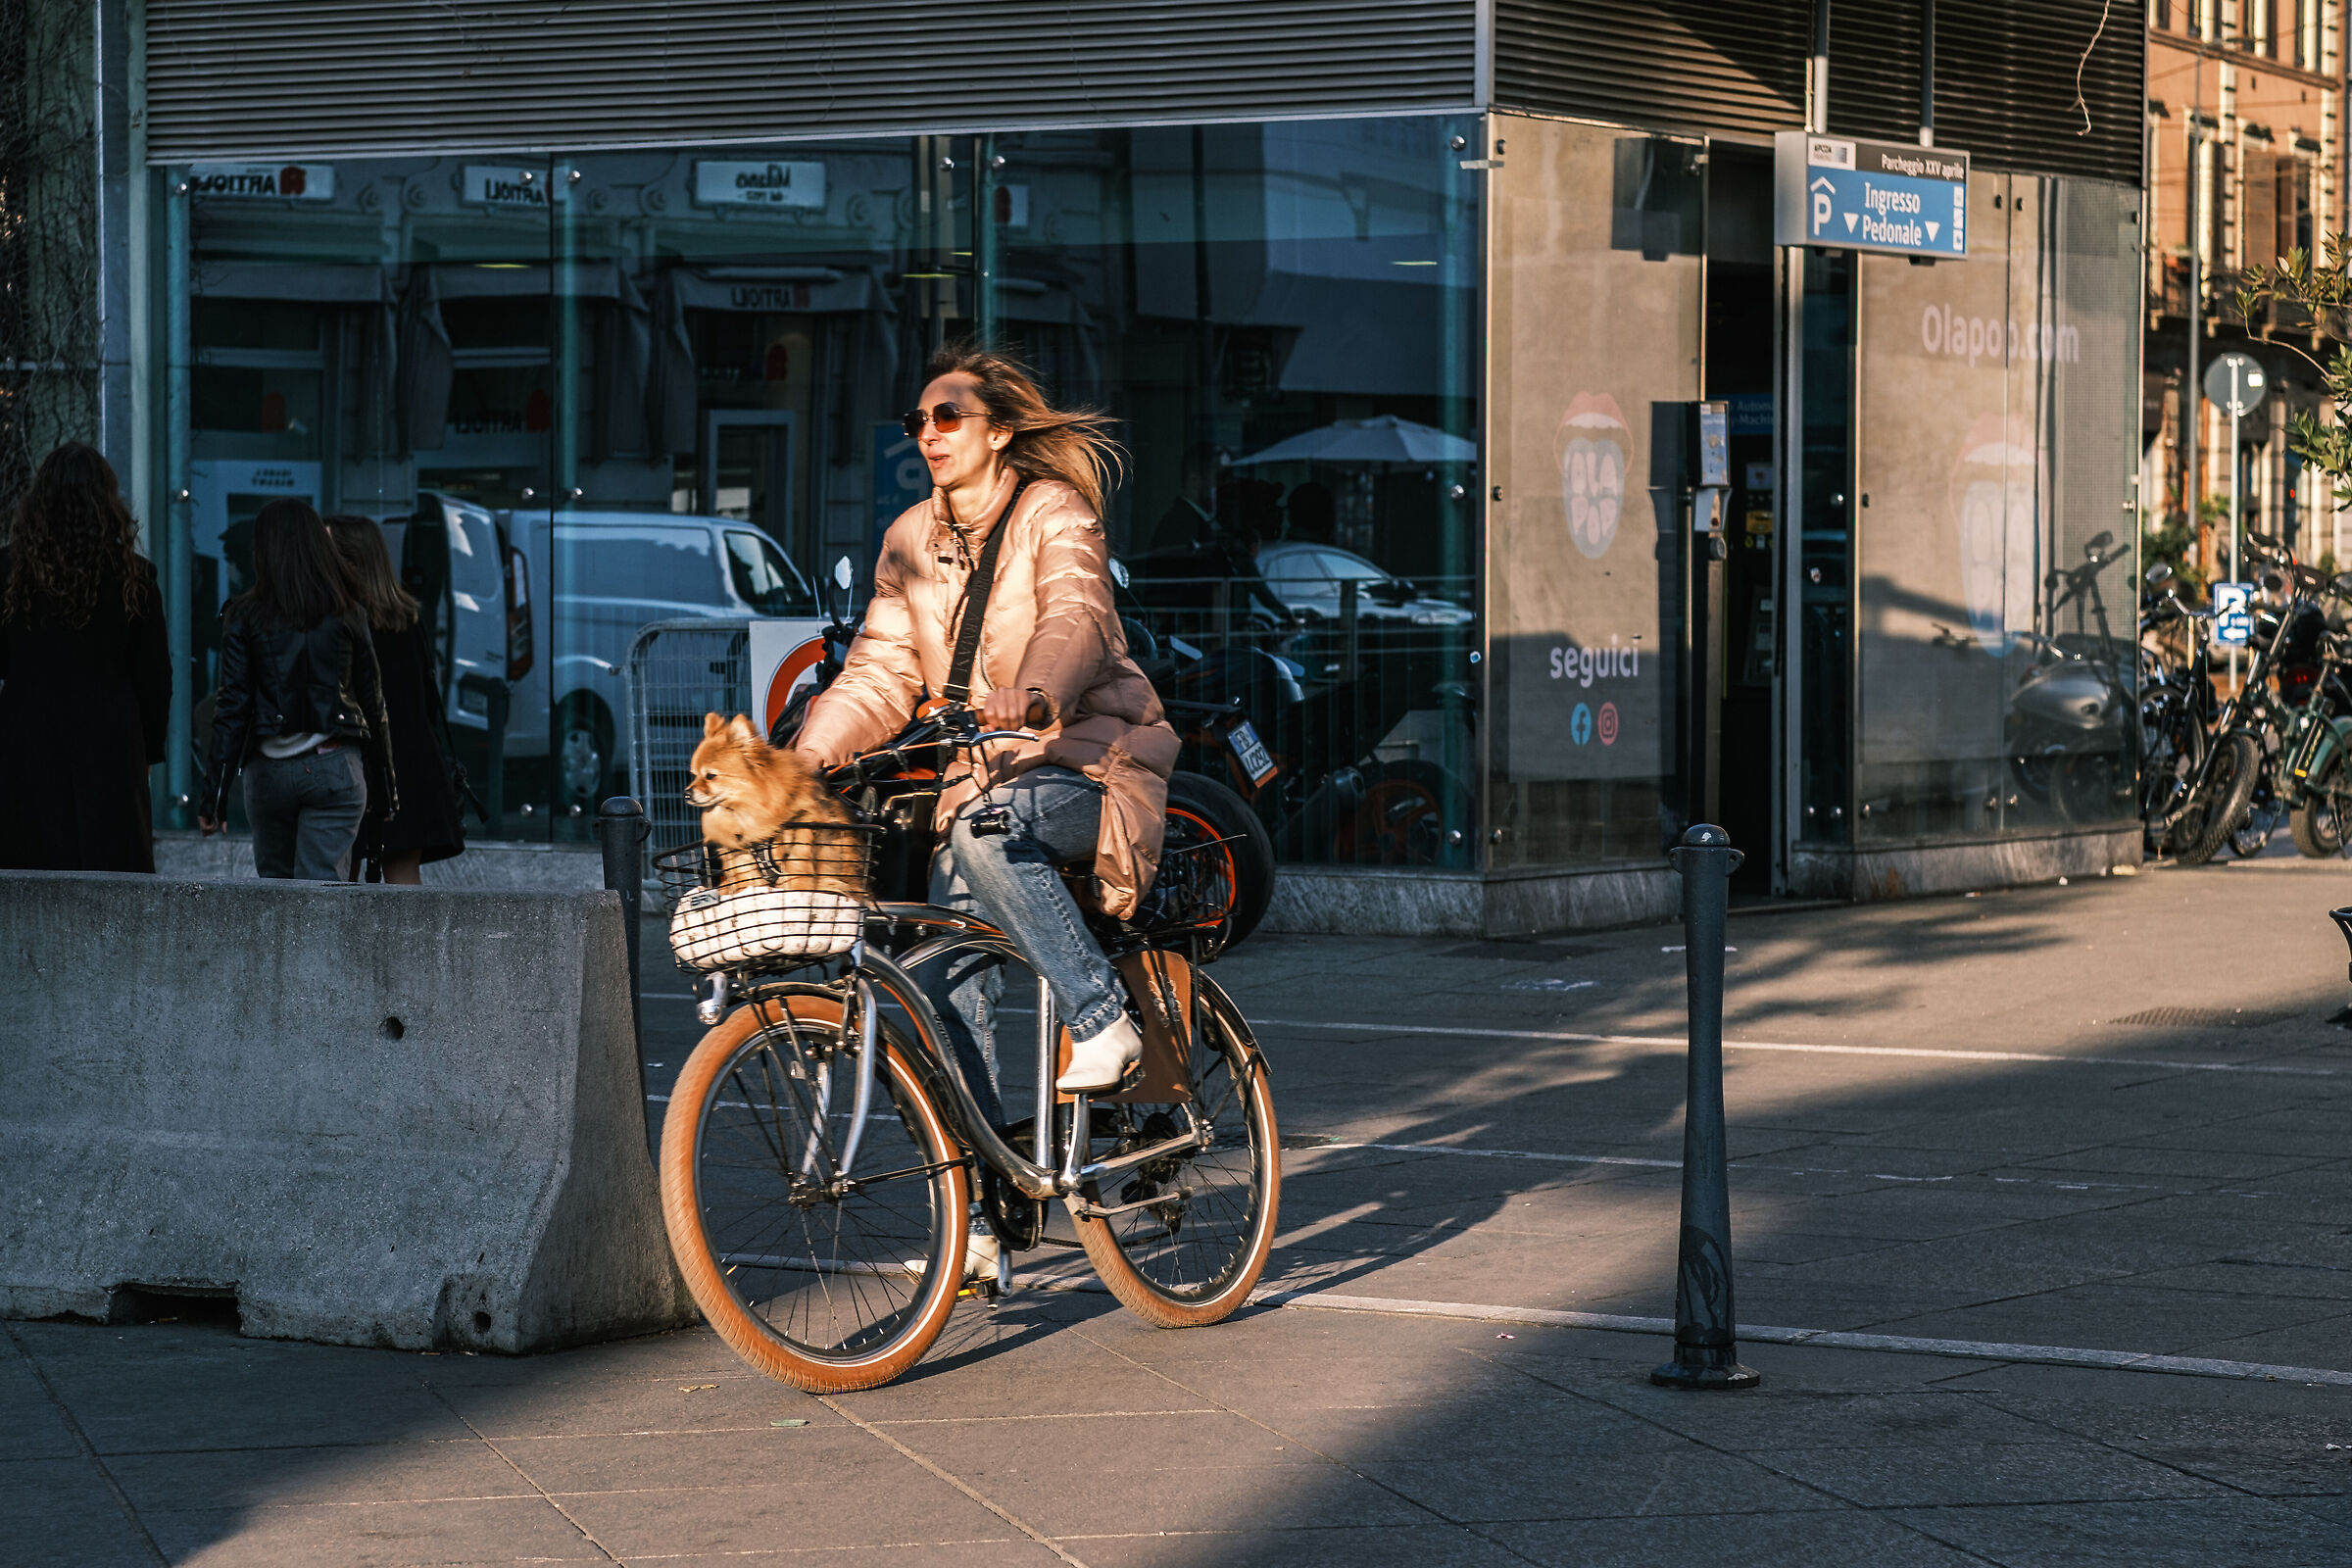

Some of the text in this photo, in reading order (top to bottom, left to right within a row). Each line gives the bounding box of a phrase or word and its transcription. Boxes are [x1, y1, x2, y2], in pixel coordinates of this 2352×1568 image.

[1882, 153, 1964, 180] Parcheggio XXV aprile
[1814, 193, 1832, 236] P
[1864, 181, 1921, 216] Ingresso
[1862, 214, 1922, 246] Pedonale
[1922, 303, 2080, 368] Olapop.com
[1737, 399, 1773, 412] Autom
[1550, 633, 1639, 688] seguici
